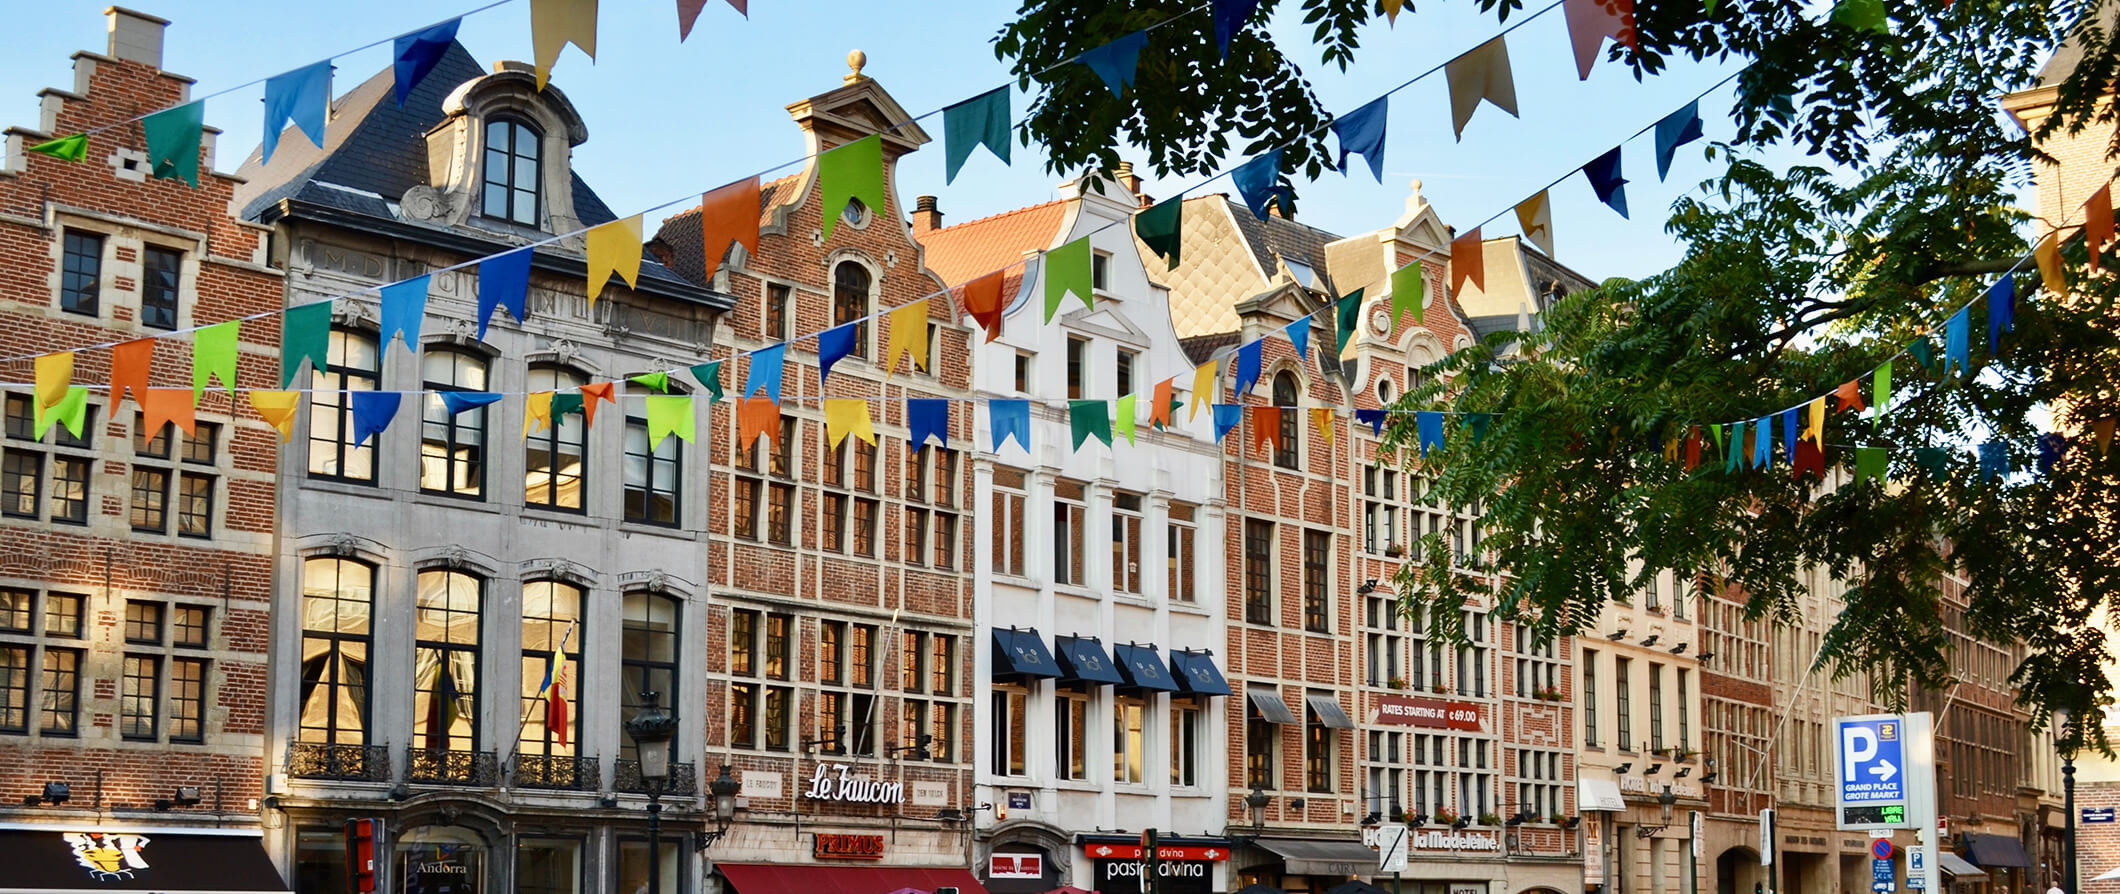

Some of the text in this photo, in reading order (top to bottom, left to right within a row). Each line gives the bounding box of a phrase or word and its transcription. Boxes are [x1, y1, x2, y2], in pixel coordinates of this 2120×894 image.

[1382, 704, 1403, 715] RATES
[1404, 706, 1436, 718] STARTING
[1437, 709, 1446, 719] AT
[1843, 727, 1878, 781] P
[805, 762, 905, 804] Le Faucon
[1845, 784, 1872, 792] GRAND
[1845, 791, 1900, 800] GROTE MARKT
[1881, 807, 1904, 815] LIBRE
[816, 833, 884, 855] PRIMUS
[416, 861, 467, 874] Andorra
